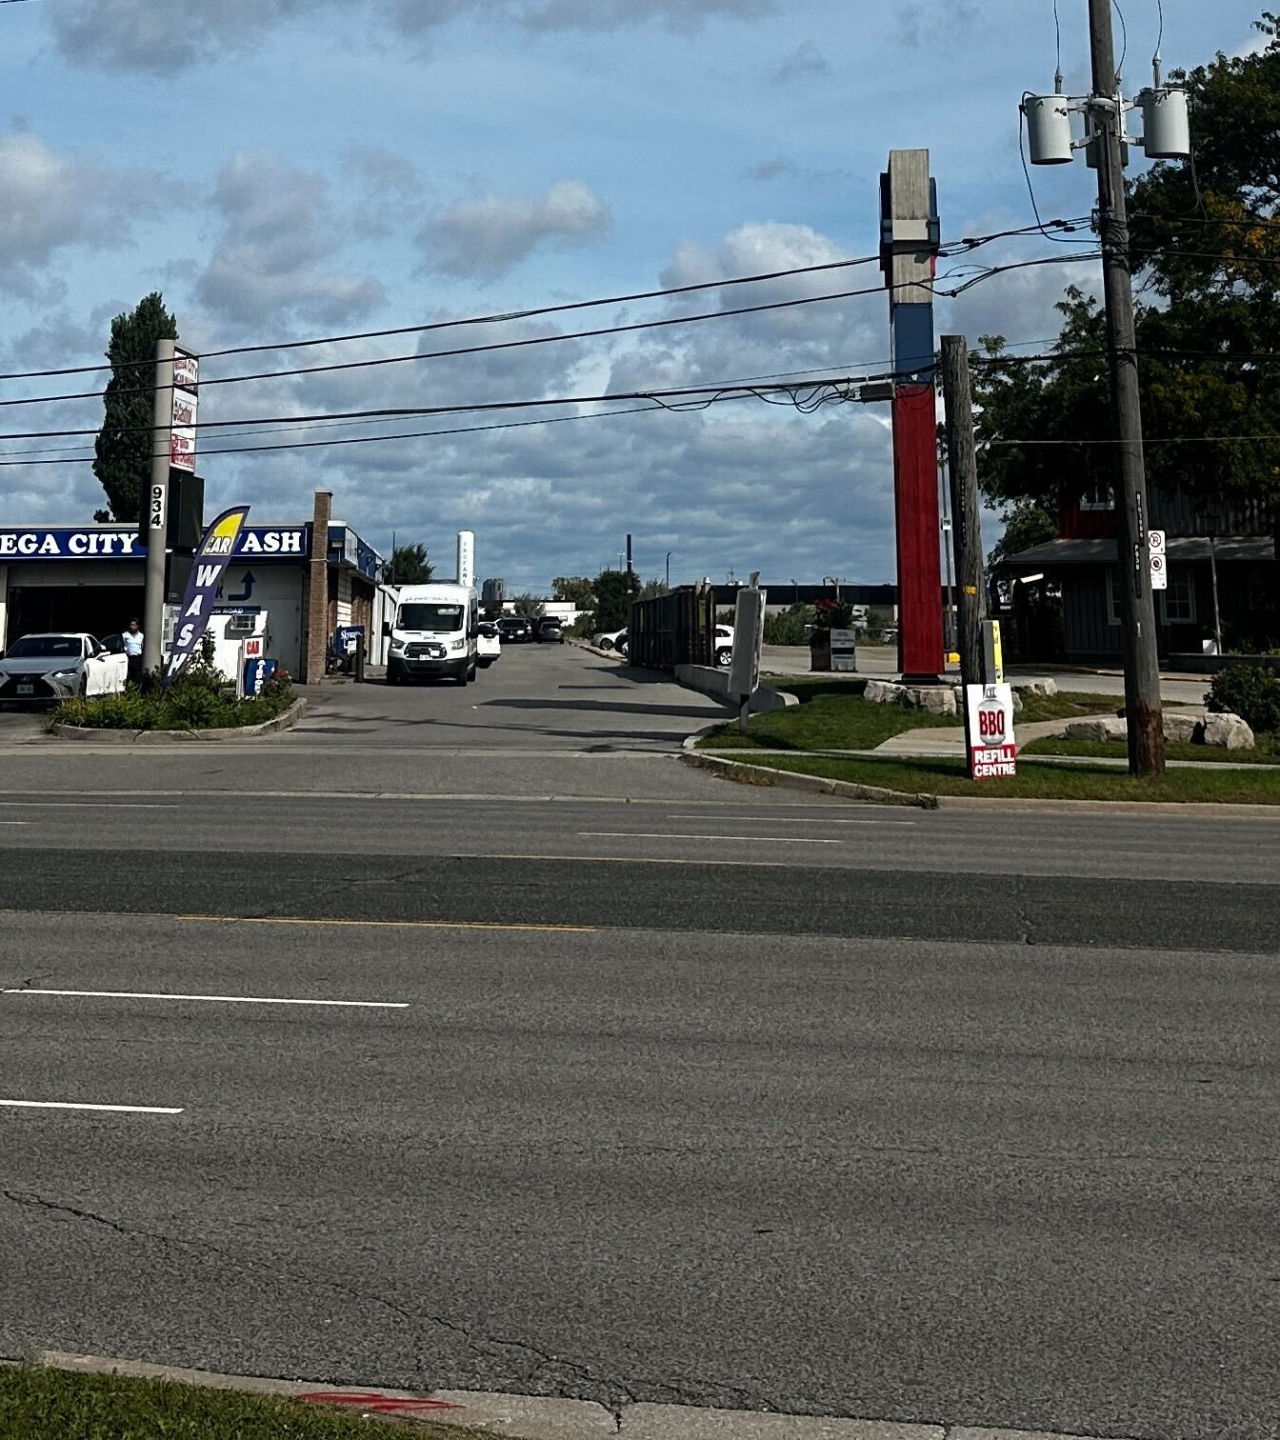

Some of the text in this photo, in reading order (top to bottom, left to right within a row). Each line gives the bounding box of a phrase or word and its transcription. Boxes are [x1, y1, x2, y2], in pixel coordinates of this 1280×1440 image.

[150, 486, 163, 527] 934
[68, 533, 139, 554] CITY
[238, 531, 302, 553] ASH
[205, 536, 231, 554] CAR
[167, 564, 222, 677] WASH
[974, 748, 1015, 763] REFILL
[974, 763, 1016, 777] CENTRE
